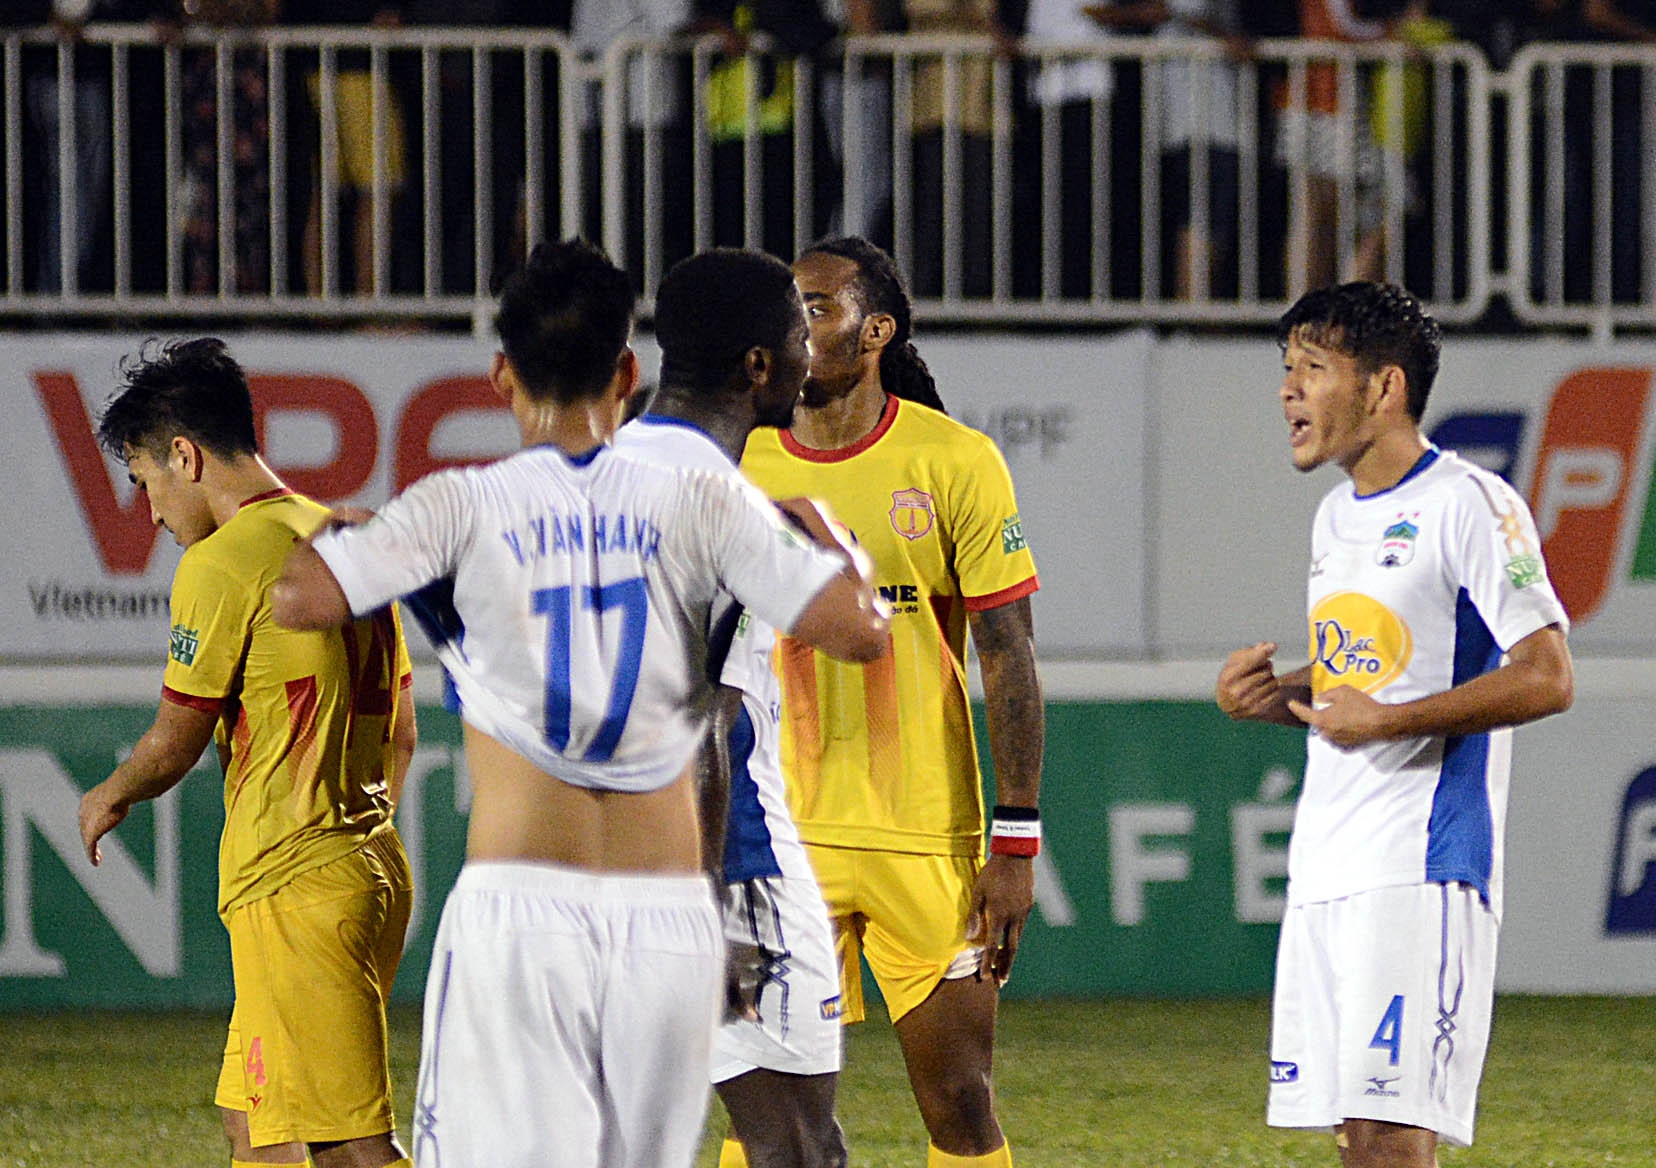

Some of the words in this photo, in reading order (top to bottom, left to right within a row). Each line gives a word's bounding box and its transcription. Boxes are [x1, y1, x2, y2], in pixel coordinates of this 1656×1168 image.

[529, 576, 648, 762] 17
[1344, 653, 1380, 674] Pro
[1369, 995, 1405, 1066] 4
[247, 1036, 266, 1086] 4
